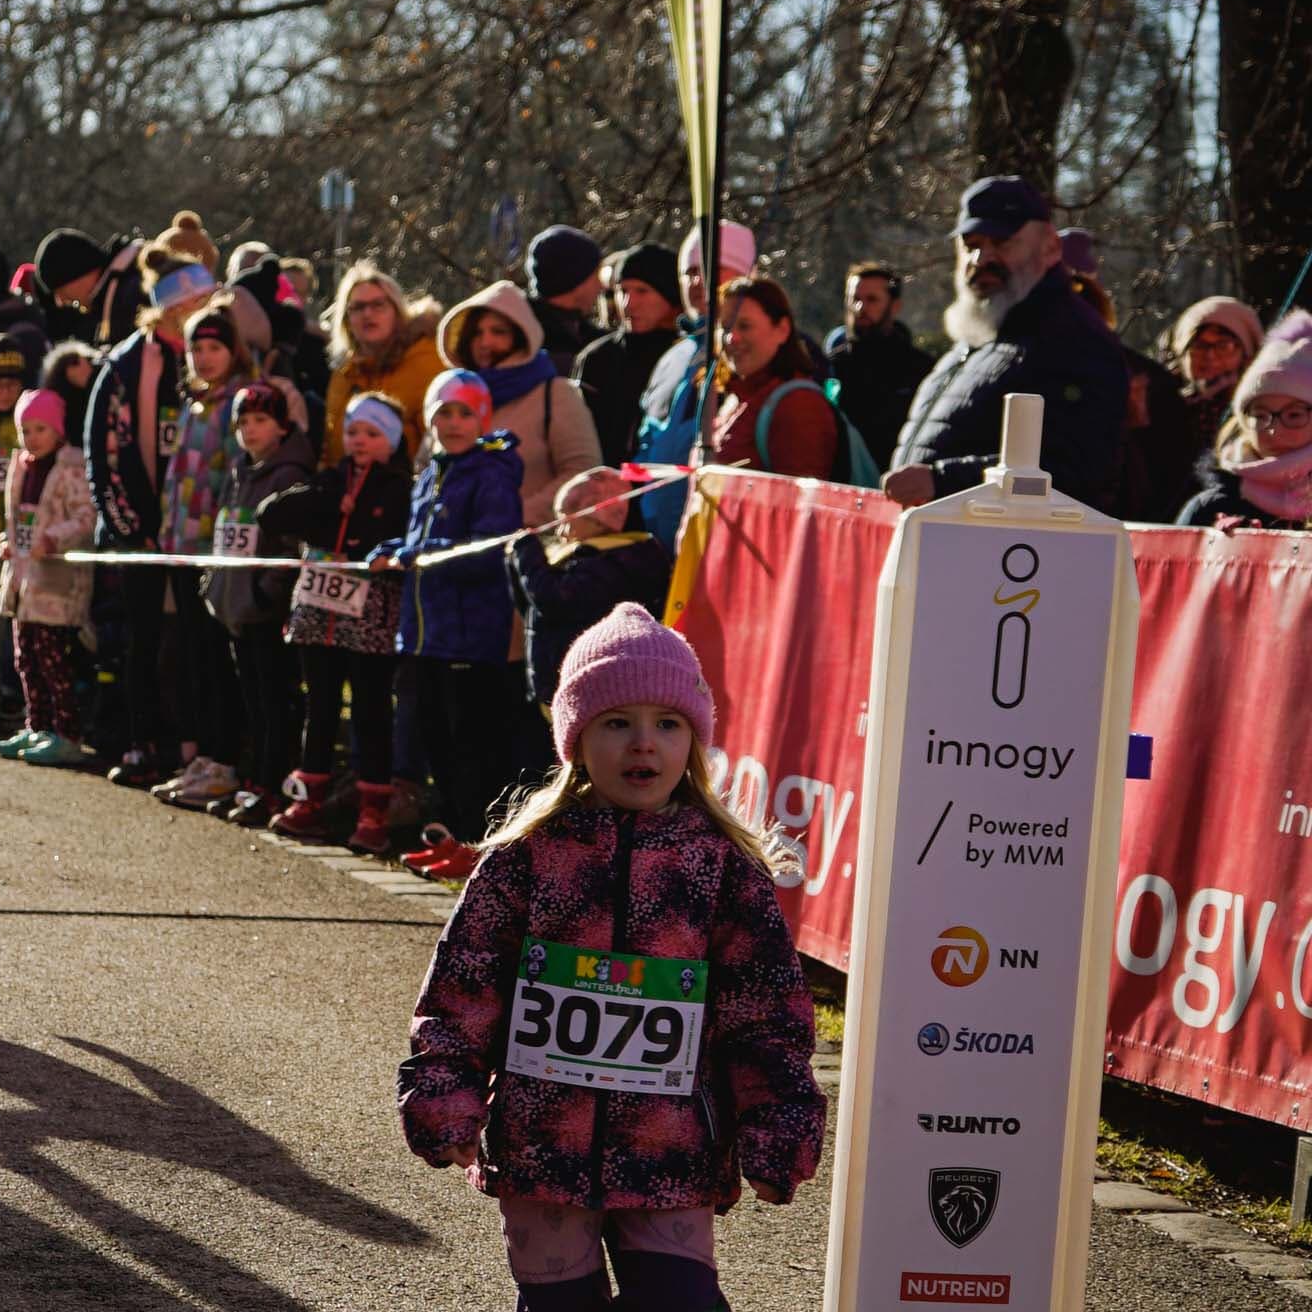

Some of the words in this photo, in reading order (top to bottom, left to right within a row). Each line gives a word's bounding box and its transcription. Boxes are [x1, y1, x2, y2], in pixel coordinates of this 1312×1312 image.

[301, 569, 361, 600] 3187
[925, 728, 1075, 780] innogy
[968, 813, 1069, 838] Powered
[965, 841, 995, 868] by
[1003, 844, 1065, 867] MVM
[998, 948, 1040, 970] NN
[514, 985, 684, 1065] 3079
[952, 1026, 1035, 1056] ŠKODA
[936, 1114, 1021, 1136] RUNTO
[936, 1174, 994, 1184] PEUGEOT
[907, 1278, 1006, 1298] NUTREND
